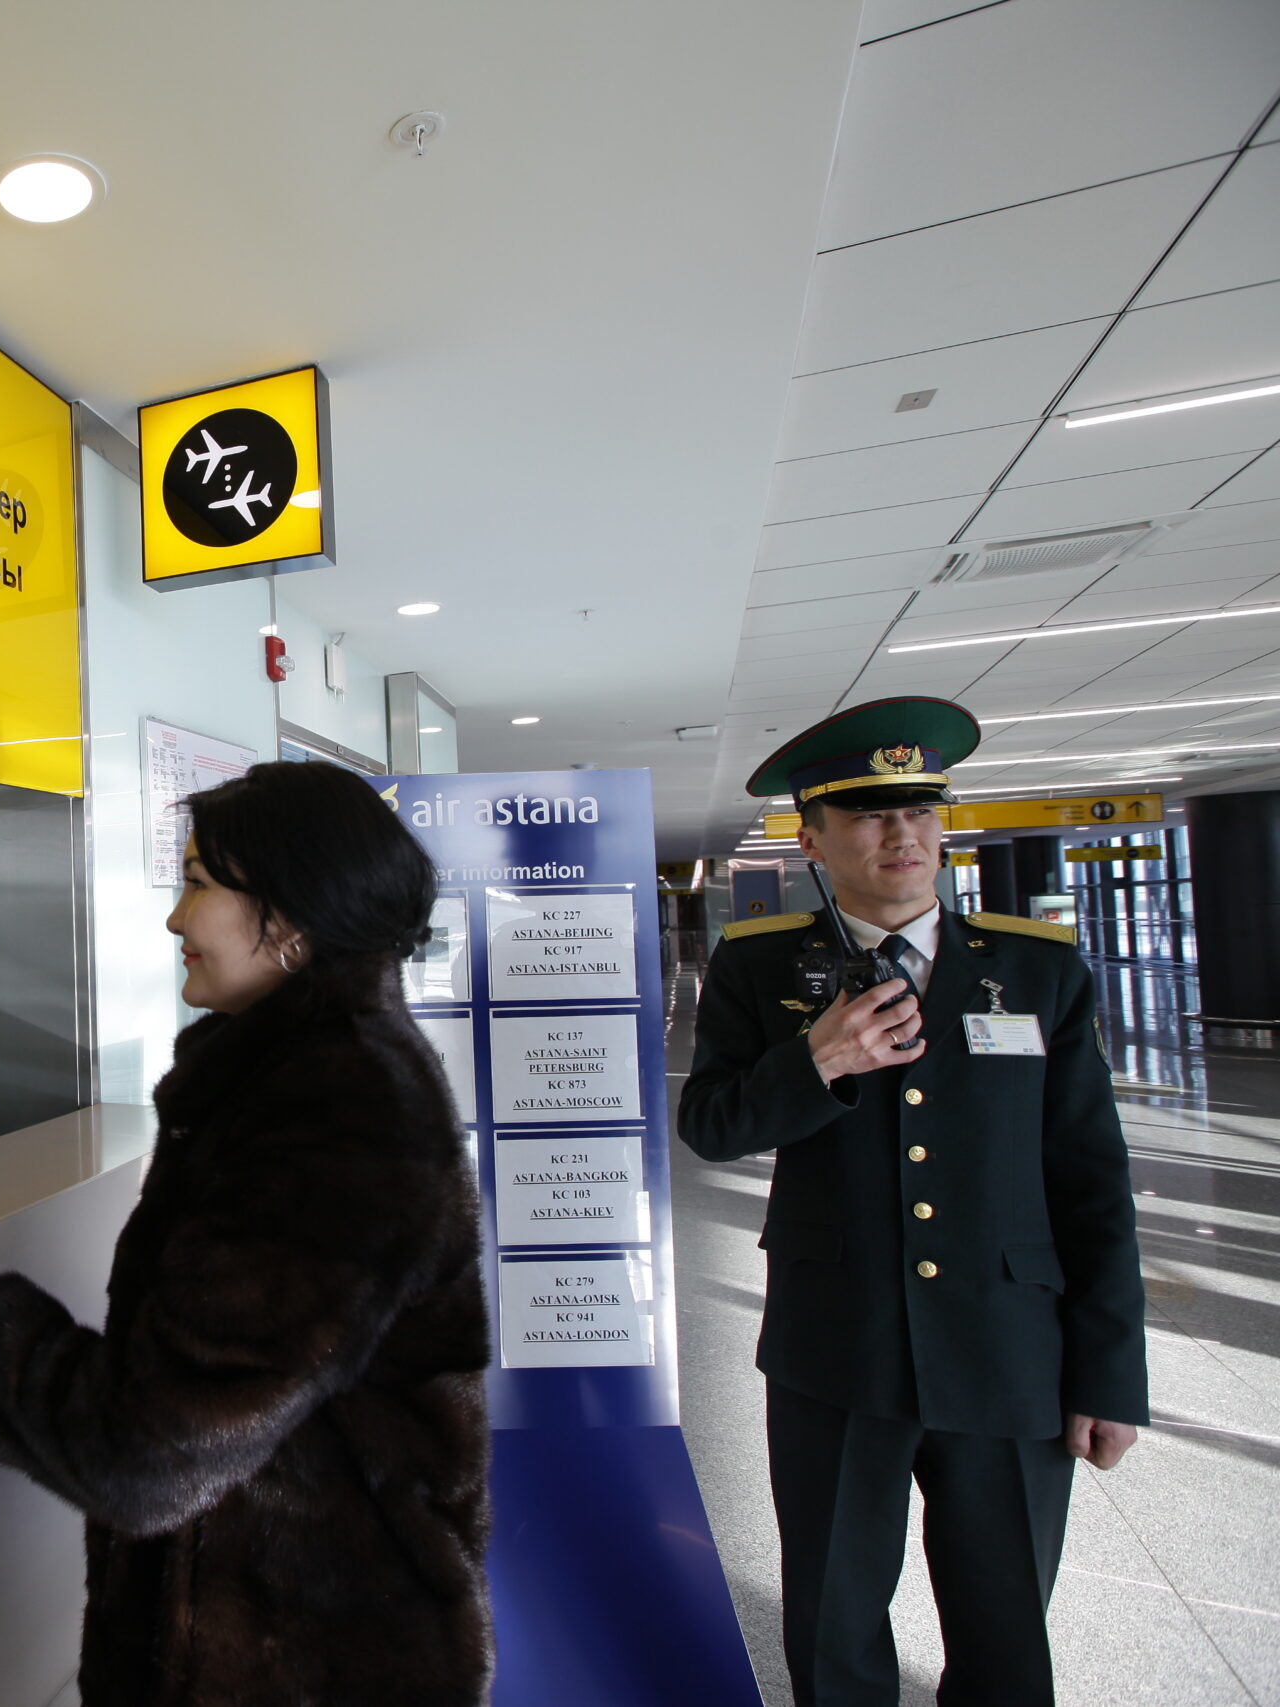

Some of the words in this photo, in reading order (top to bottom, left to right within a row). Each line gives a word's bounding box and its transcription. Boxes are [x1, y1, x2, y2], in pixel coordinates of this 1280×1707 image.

[412, 793, 460, 827] air
[474, 793, 599, 826] astana
[463, 861, 585, 881] information
[543, 911, 561, 921] KC
[563, 910, 581, 920] 227
[512, 927, 613, 939] ASTANA-BEIJING
[544, 946, 562, 956] KC
[564, 945, 582, 955] 917
[507, 962, 621, 974] ASTANA-ISTANBUL
[547, 1032, 566, 1042] KC
[567, 1031, 583, 1041] 137
[525, 1048, 607, 1059] ASTANA-SAINT
[529, 1062, 604, 1073] PETERSBURG
[548, 1080, 566, 1090] KC
[568, 1080, 587, 1089] 873
[513, 1097, 623, 1109] ASTANA-MOSCOW
[551, 1154, 569, 1164] KC
[571, 1154, 589, 1163] 231
[513, 1171, 628, 1183] ASTANA-BANGKOK
[552, 1190, 570, 1200] KC
[573, 1190, 591, 1199] 103
[530, 1207, 614, 1218] ASTANA-KIEV
[555, 1277, 573, 1287] KC
[575, 1277, 594, 1287] 279
[530, 1294, 620, 1306] ASTANA-OMSK
[556, 1312, 574, 1322] KC
[576, 1312, 595, 1322] 941
[523, 1329, 629, 1341] ASTANA-LONDON
